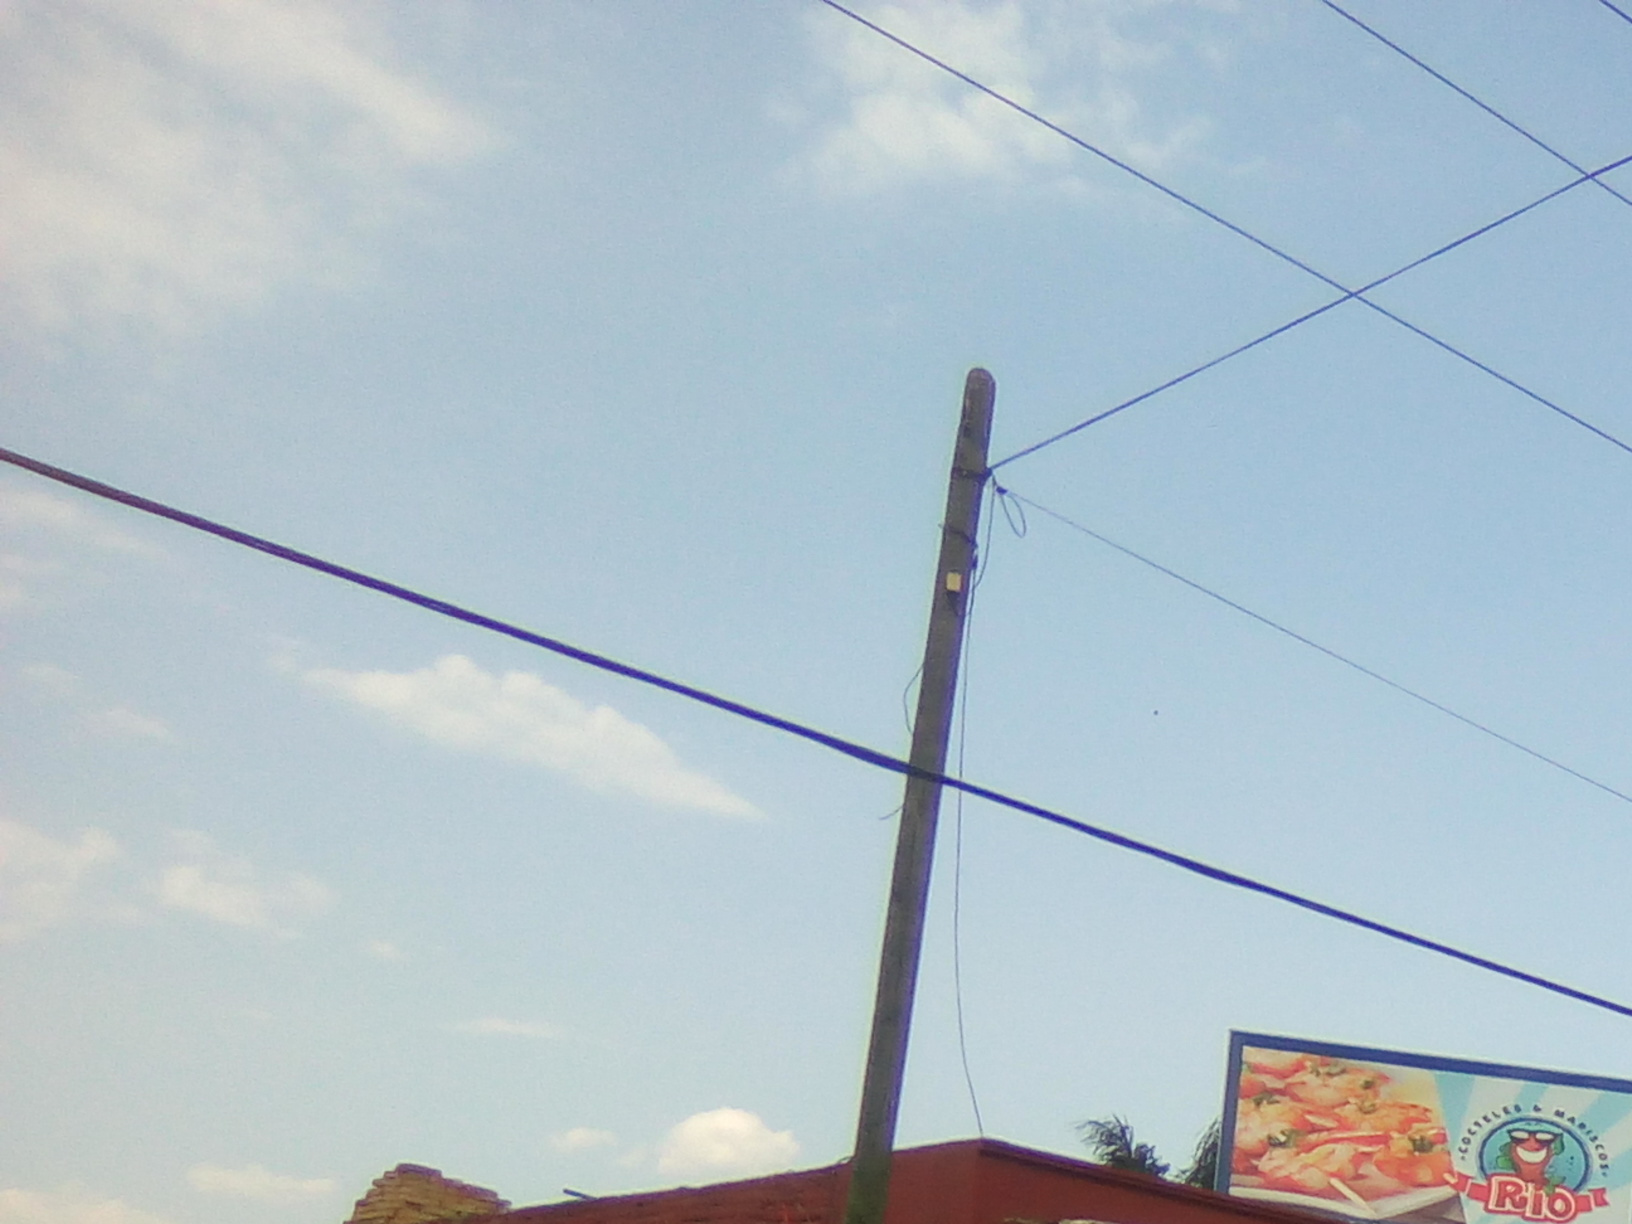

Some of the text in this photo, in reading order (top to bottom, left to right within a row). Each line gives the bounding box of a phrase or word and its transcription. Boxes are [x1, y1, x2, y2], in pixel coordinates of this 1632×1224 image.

[1458, 1104, 1522, 1154] COCTELES
[1554, 1109, 1610, 1171] MARISCOS
[1489, 1175, 1576, 1222] RIO
